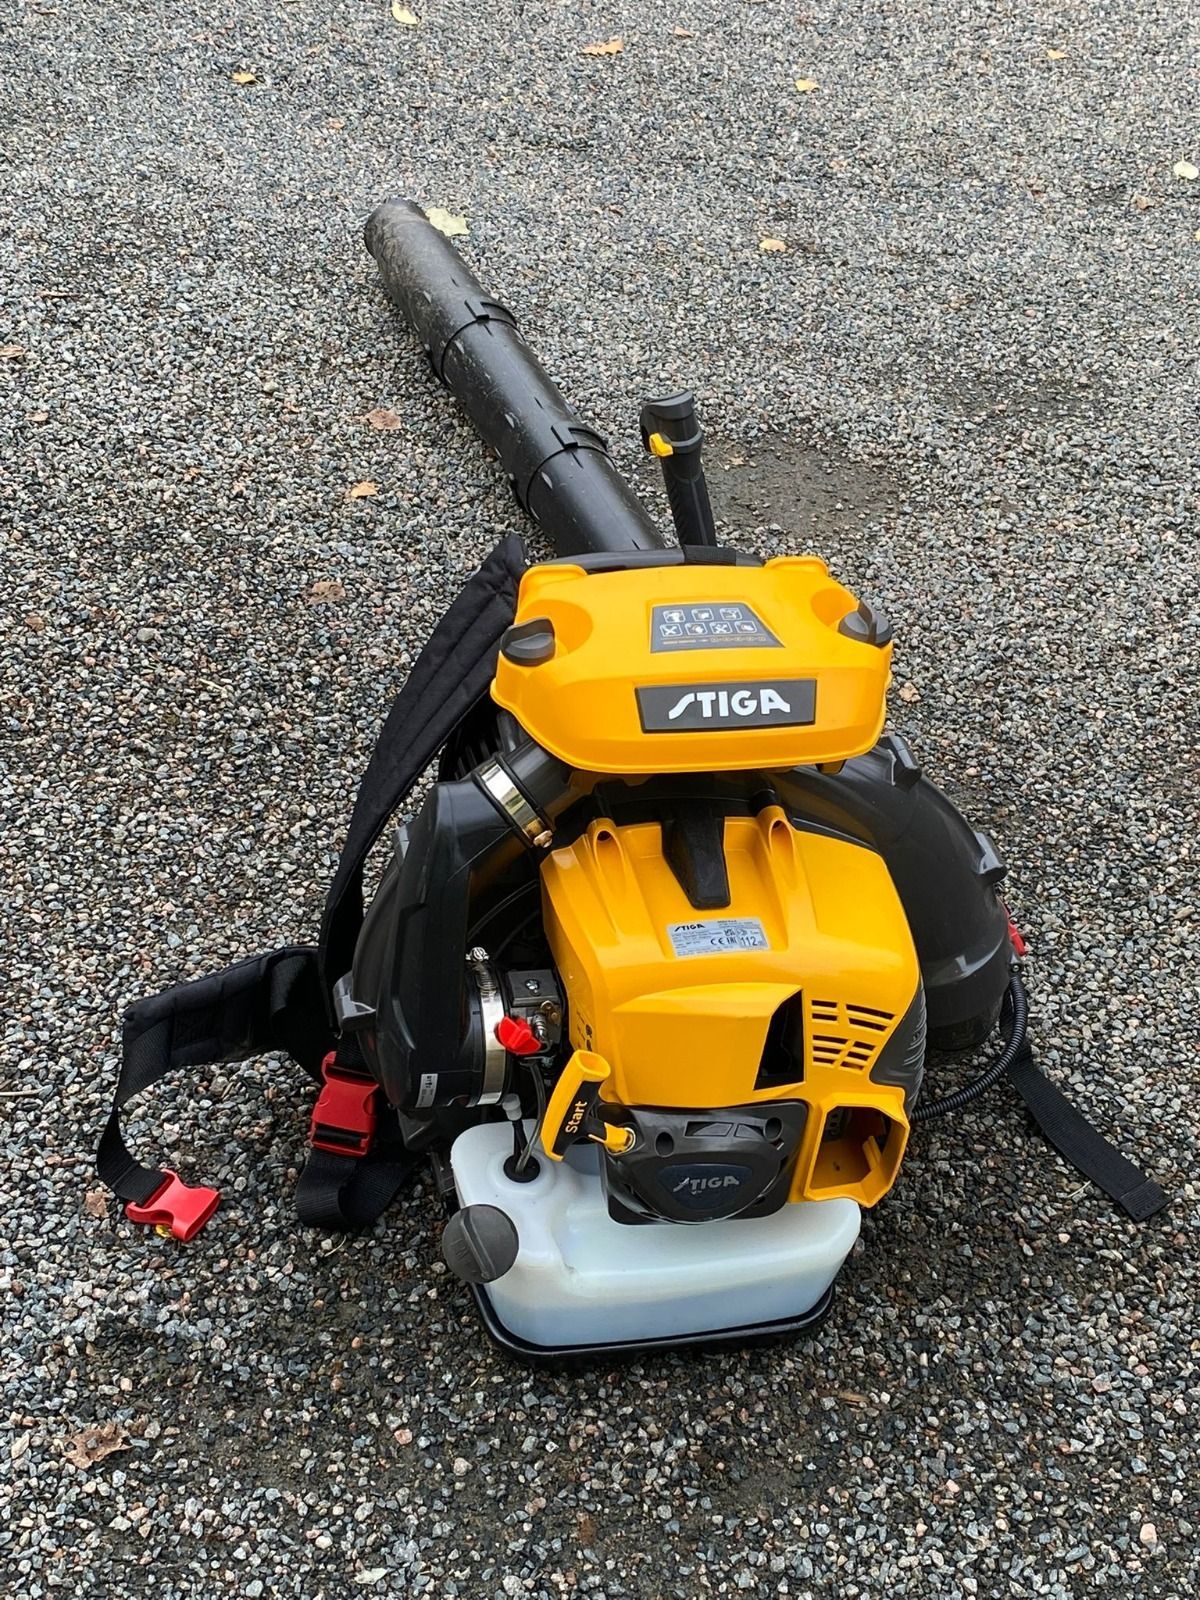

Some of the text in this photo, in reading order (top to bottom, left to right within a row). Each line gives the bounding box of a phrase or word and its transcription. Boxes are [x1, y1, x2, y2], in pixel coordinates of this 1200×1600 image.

[668, 689, 791, 720] STIGA
[674, 923, 705, 932] STIGA
[741, 936, 758, 947] 112
[565, 1100, 588, 1134] Start
[673, 1175, 740, 1193] STIGA
